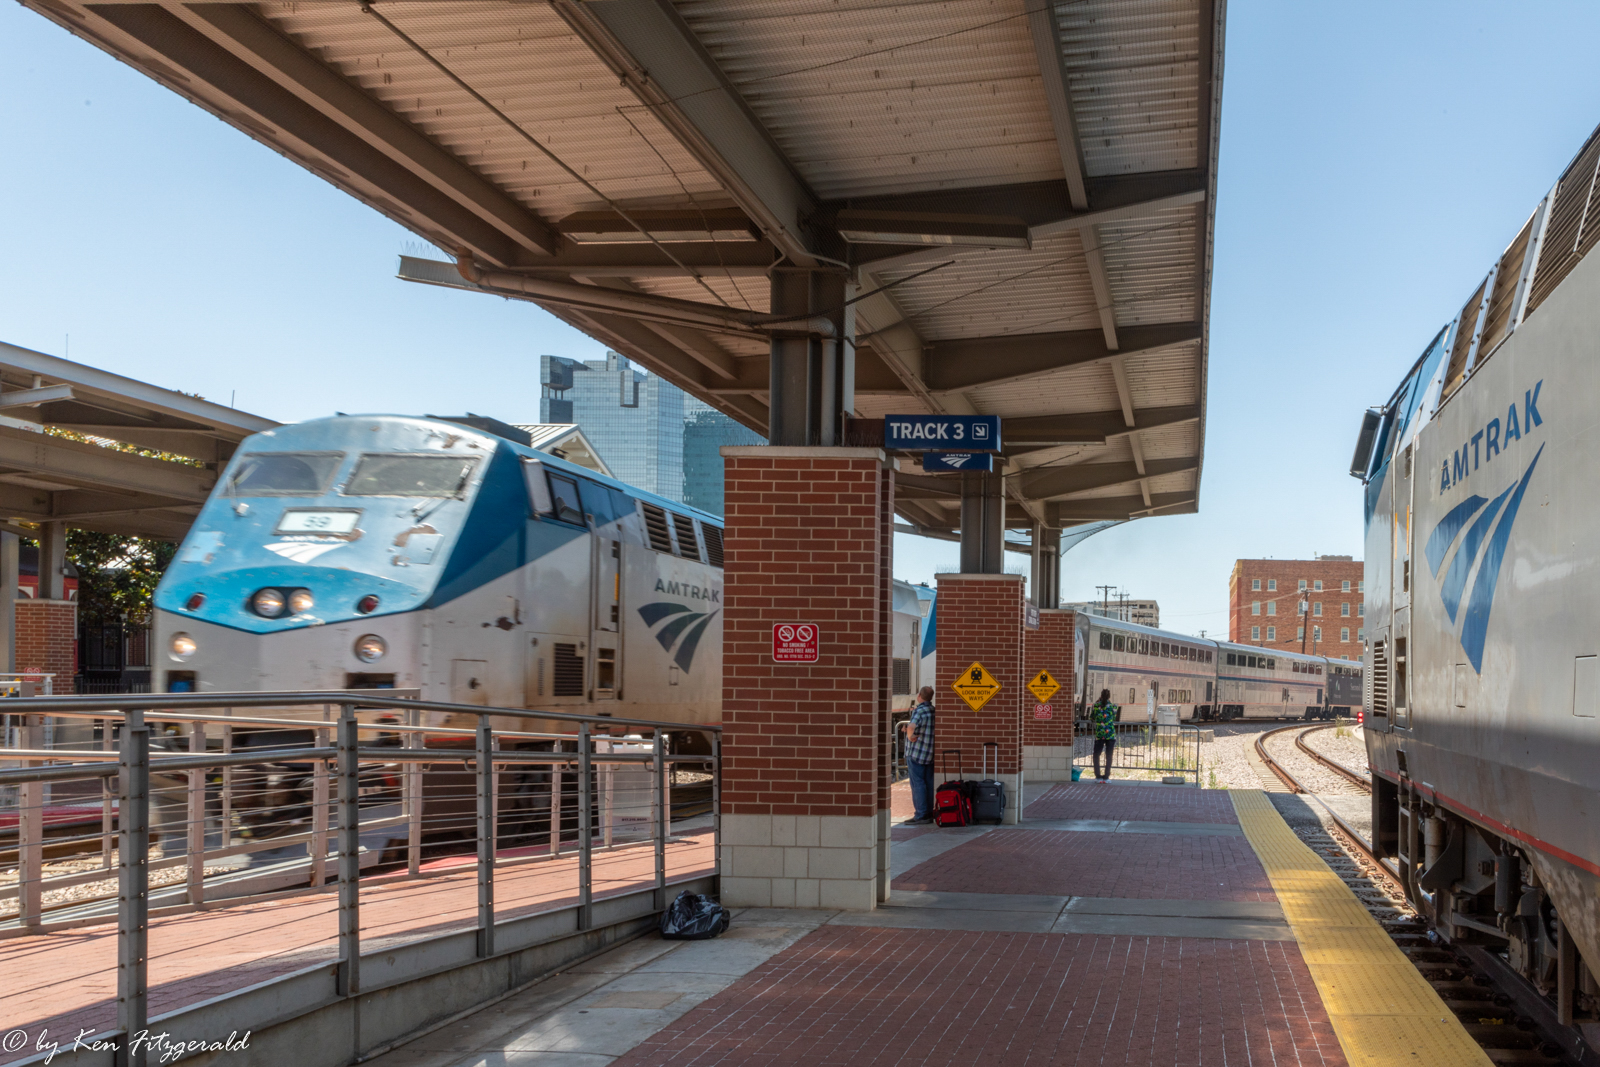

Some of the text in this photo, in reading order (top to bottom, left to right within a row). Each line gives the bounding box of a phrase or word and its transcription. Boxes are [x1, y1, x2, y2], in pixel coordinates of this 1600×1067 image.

[890, 422, 965, 440] TRACK 3
[1440, 379, 1543, 496] AMTRAK
[654, 578, 720, 603] AMTRAK
